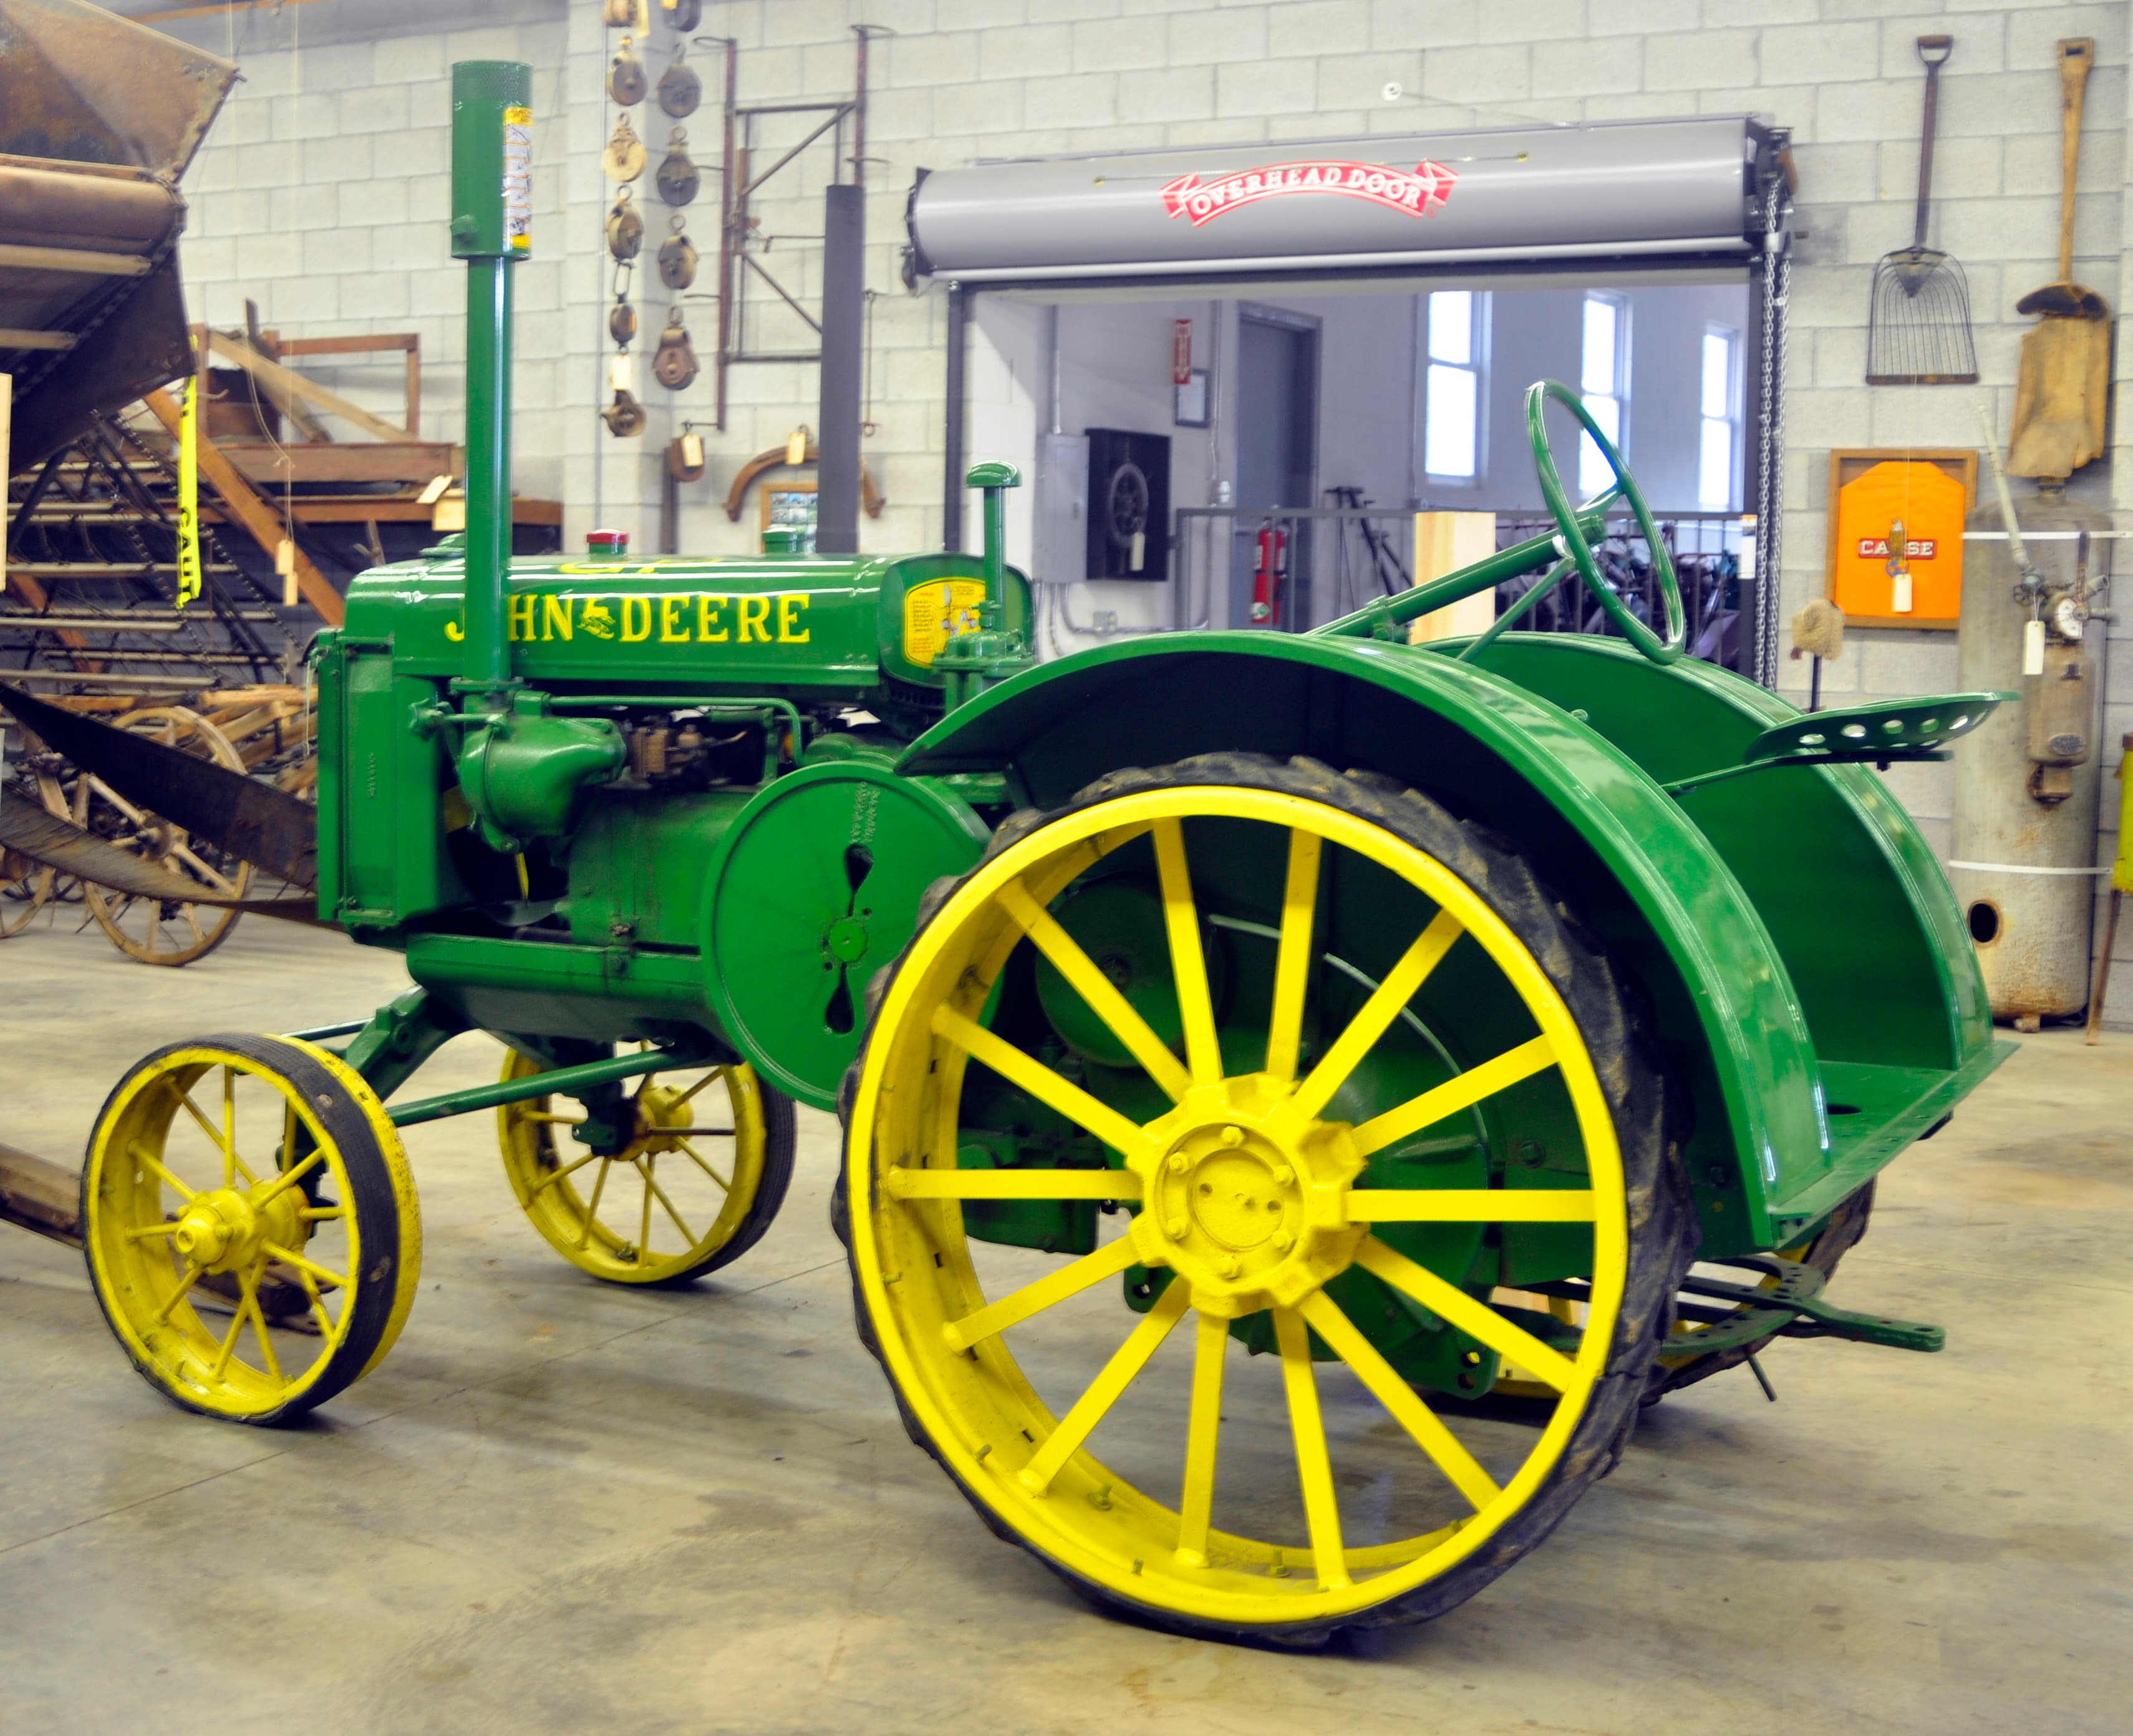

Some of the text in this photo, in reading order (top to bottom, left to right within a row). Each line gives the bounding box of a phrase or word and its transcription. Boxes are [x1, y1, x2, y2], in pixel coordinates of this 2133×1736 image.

[1191, 166, 1422, 215] OVERHEAD DOOR
[1859, 540, 1934, 556] CASE
[443, 594, 810, 643] JHN DEERE
